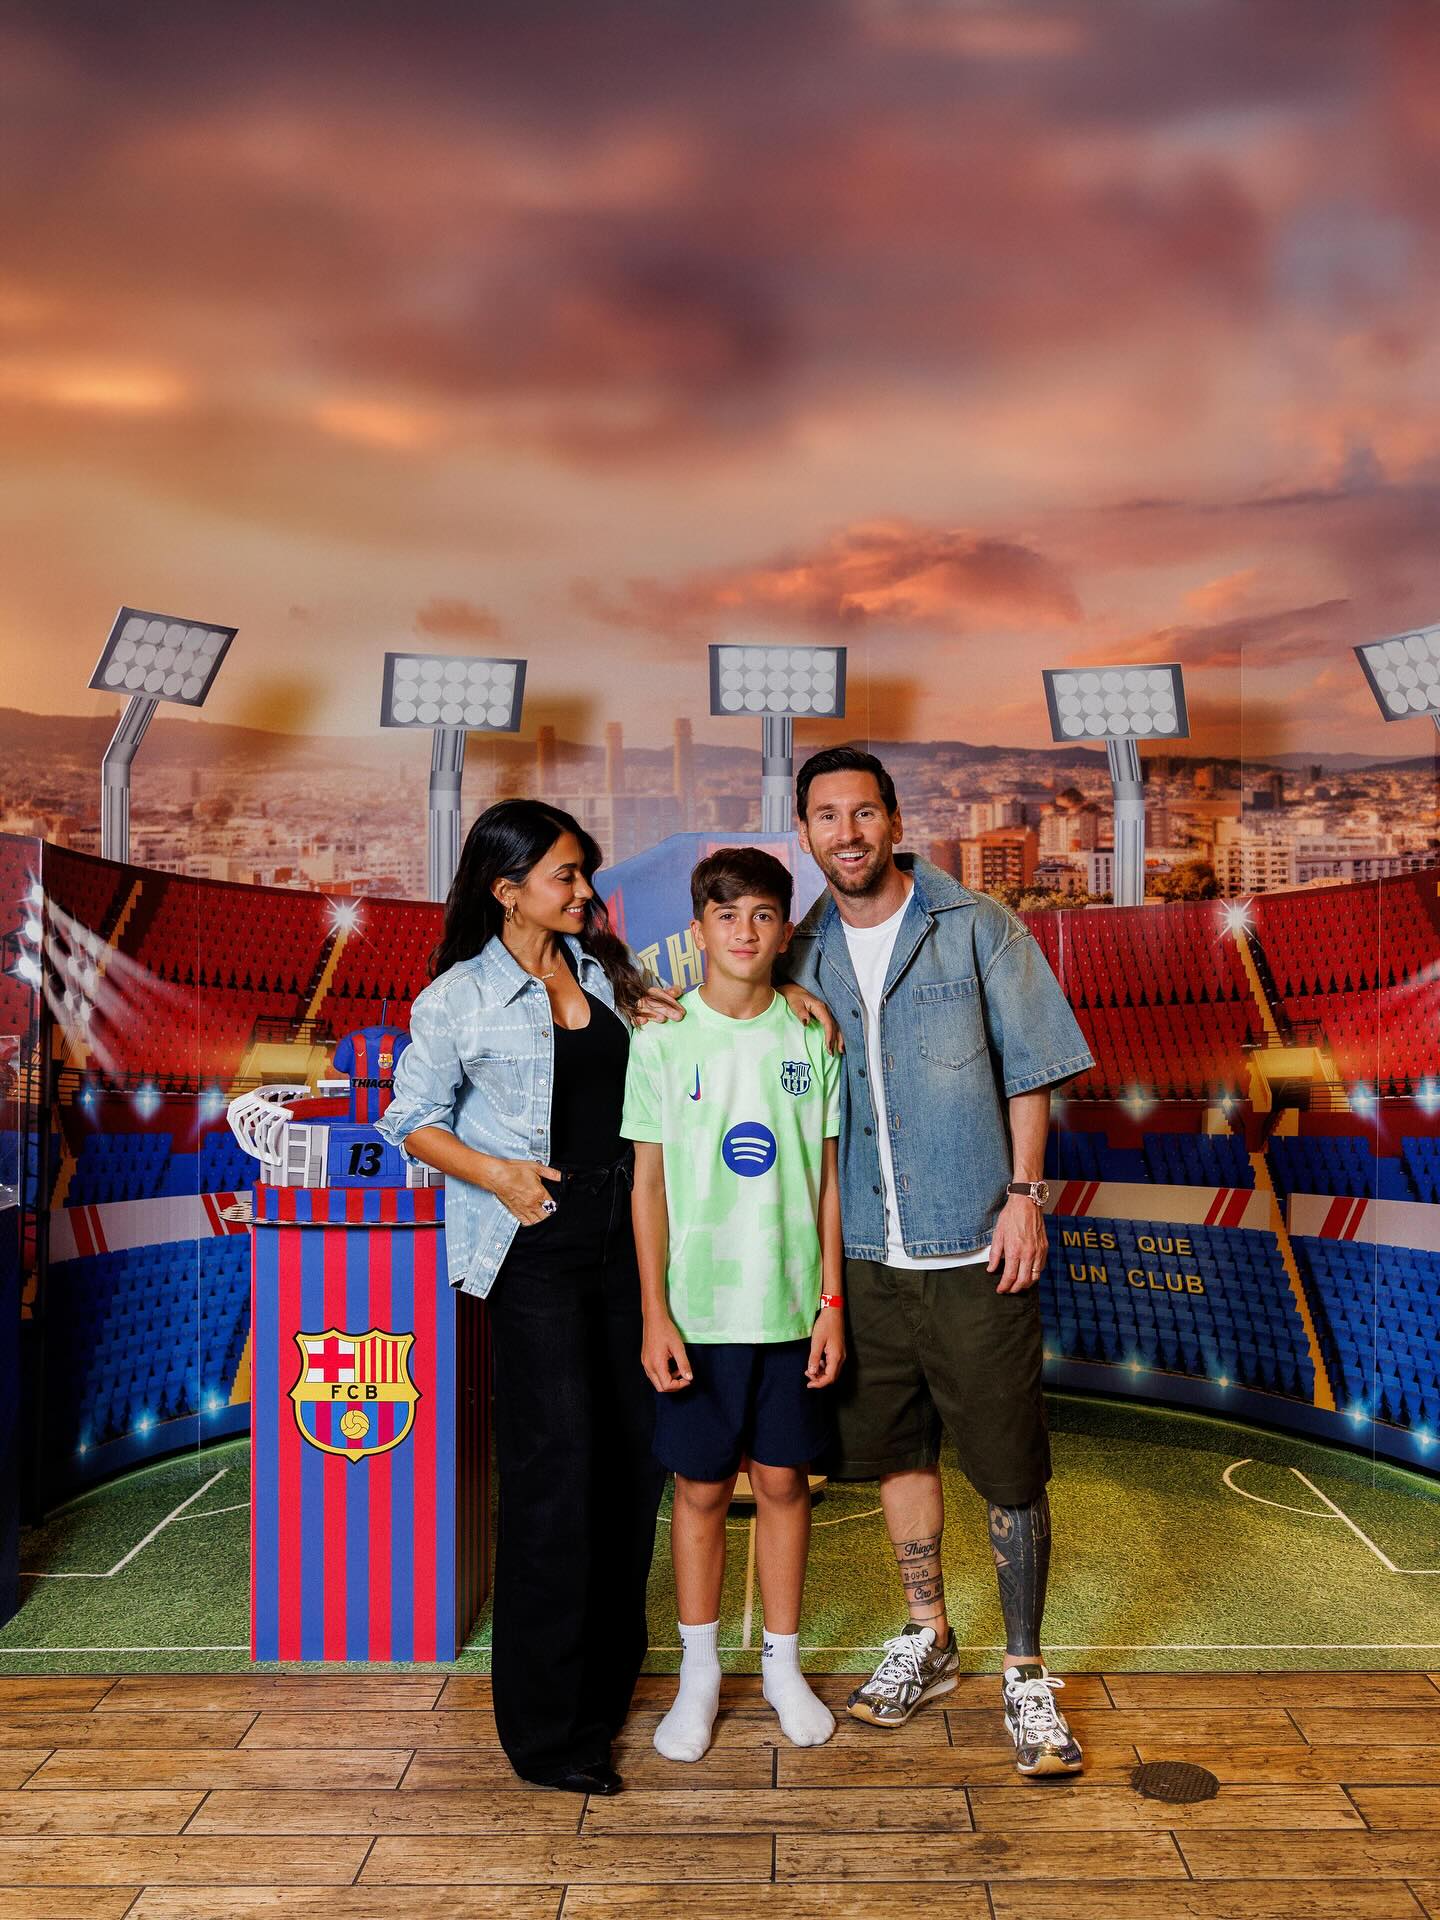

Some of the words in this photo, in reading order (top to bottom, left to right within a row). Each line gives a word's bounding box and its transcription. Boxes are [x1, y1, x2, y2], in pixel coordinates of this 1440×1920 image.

[351, 1079, 394, 1089] THIAGO
[348, 1142, 383, 1177] 13
[1062, 1228, 1116, 1249] MÉS
[1137, 1236, 1192, 1255] QUE
[1070, 1264, 1107, 1283] UN
[1127, 1269, 1204, 1294] CLUB
[904, 1542, 935, 1557] Thiago
